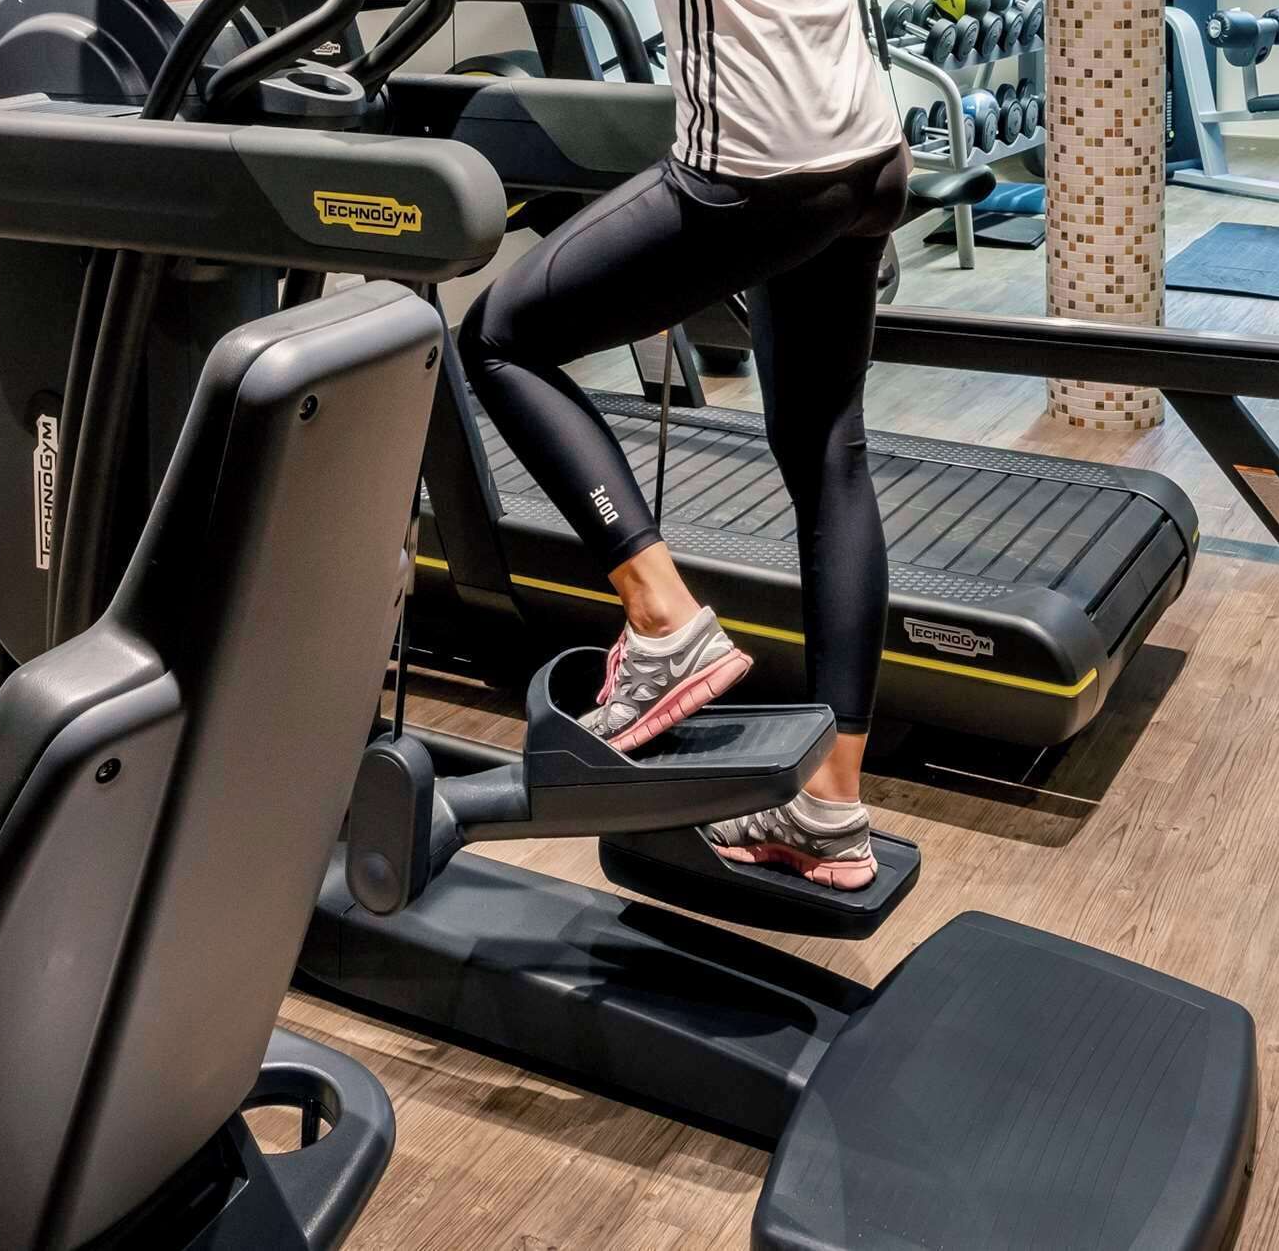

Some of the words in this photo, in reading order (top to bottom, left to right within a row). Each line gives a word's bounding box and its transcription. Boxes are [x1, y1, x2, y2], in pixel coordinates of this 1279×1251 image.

[316, 196, 417, 229] TECHNOGYM
[589, 484, 620, 525] DOPE
[905, 621, 992, 652] TECHNOGYM
